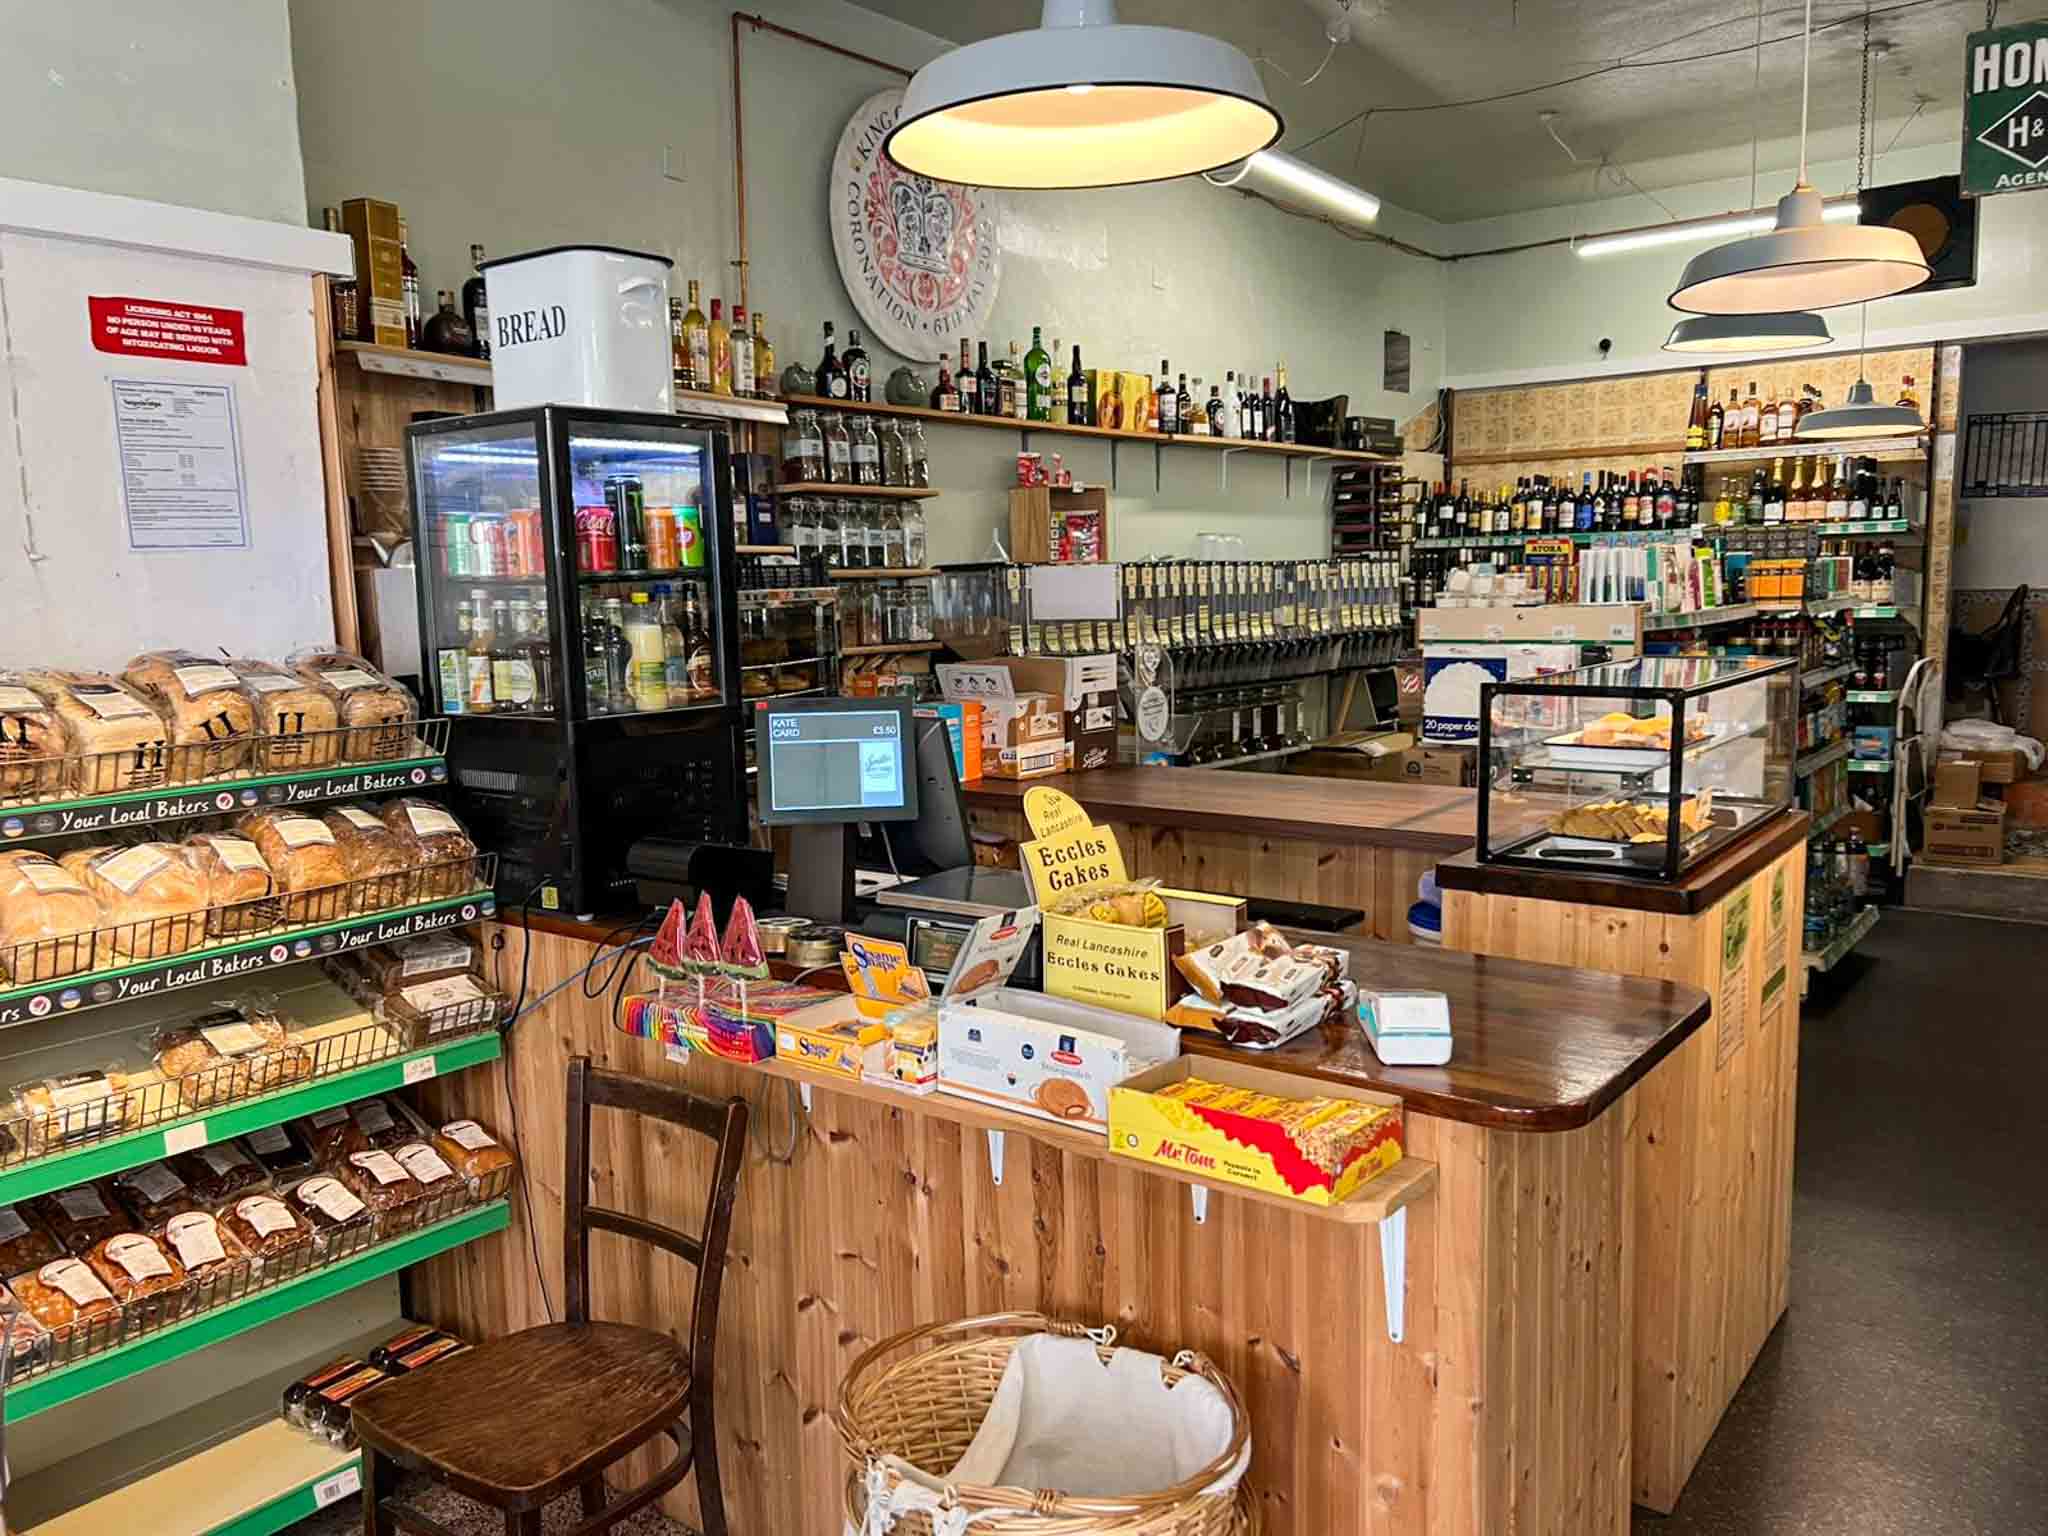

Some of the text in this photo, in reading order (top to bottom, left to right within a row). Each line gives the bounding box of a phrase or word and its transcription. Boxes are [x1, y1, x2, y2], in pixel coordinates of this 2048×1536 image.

[848, 182, 917, 331] CORONATION
[497, 305, 566, 348] BREAD
[773, 718, 798, 728] KATE
[773, 728, 800, 738] CARD
[1424, 719, 1437, 729] 20
[1438, 722, 1463, 731] paper
[288, 774, 406, 800] Your Local Bakers
[60, 798, 209, 831] Your Local Bakers
[1038, 839, 1107, 867] Eccles
[1049, 863, 1110, 891] Cakes
[340, 913, 457, 948] Your Local Bakers
[1056, 934, 1149, 959] Real Lancashire
[118, 954, 264, 998] Your Local Bakers
[1047, 952, 1099, 973] Eccles
[1180, 1144, 1217, 1170] Tom
